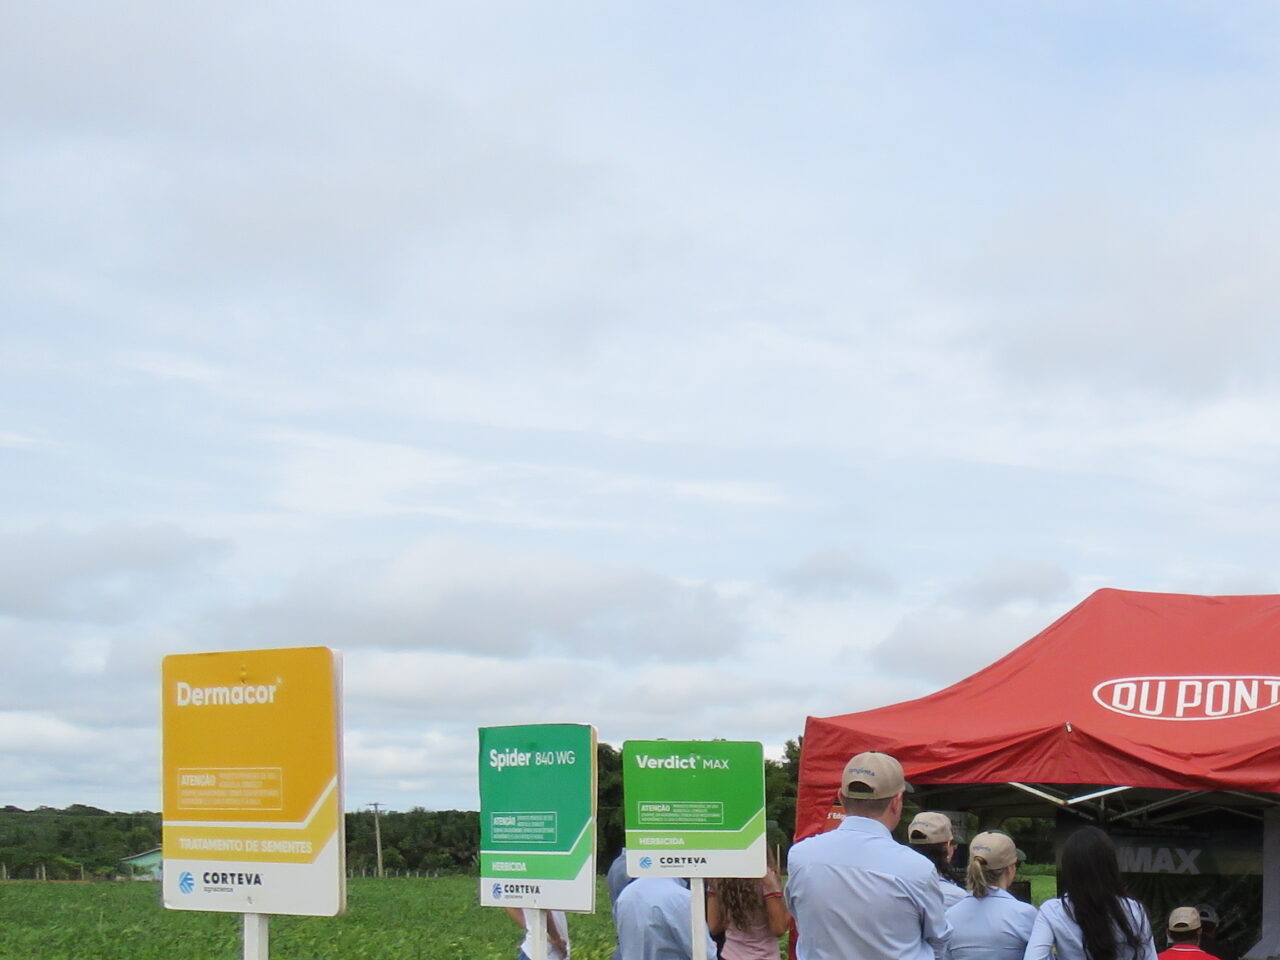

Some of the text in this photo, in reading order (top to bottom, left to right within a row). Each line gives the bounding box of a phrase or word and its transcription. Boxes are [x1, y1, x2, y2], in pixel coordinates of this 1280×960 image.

[176, 681, 278, 706] Dermacor
[489, 748, 576, 772] Spider 840 WG
[636, 754, 730, 769] Verdict MAX
[245, 839, 258, 852] DE
[659, 857, 707, 865] CORTEVA
[202, 871, 263, 886] CORTEVA
